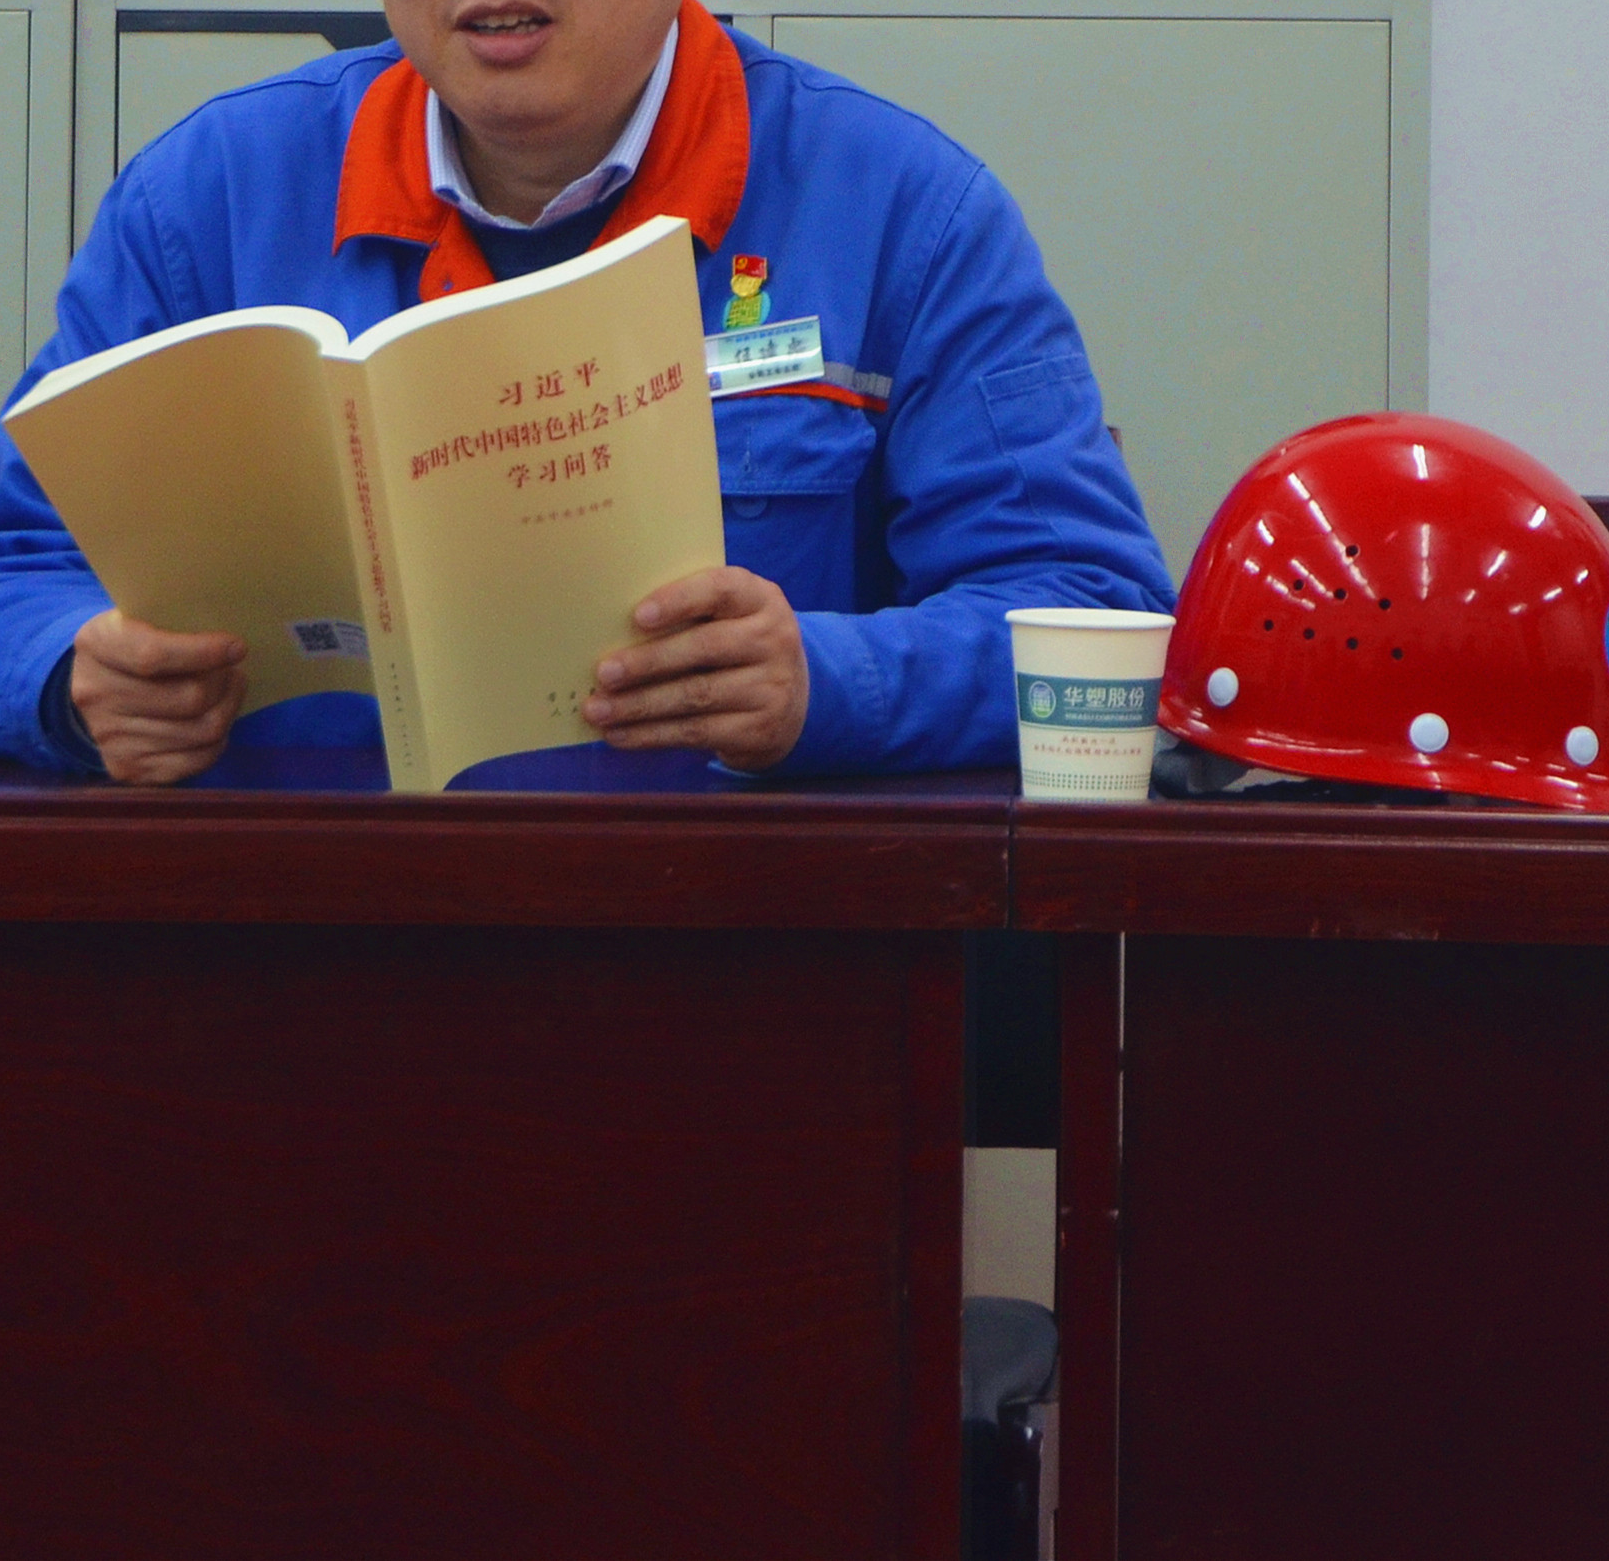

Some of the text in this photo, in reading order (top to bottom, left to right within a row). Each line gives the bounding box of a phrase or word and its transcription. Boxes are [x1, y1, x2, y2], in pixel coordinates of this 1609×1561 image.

[499, 357, 601, 406] 习近平
[410, 362, 684, 480] 新时代中国特色社会主义思想
[508, 443, 612, 488] 学习问答
[1064, 686, 1145, 708] 华塑股份
